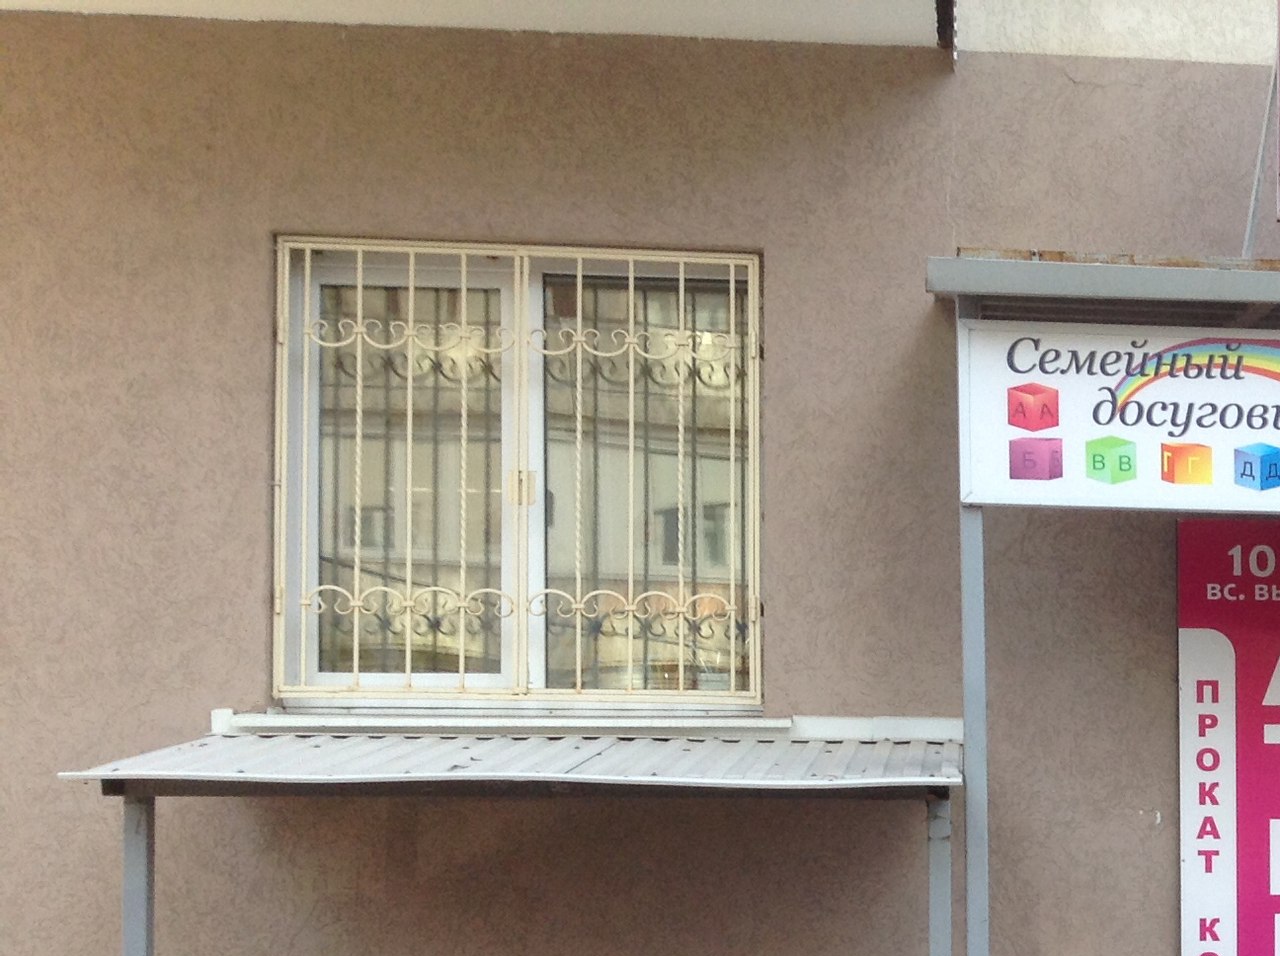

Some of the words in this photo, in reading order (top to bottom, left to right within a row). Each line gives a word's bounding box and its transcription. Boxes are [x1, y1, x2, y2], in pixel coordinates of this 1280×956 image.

[1007, 336, 1245, 381] Семейный
[1228, 545, 1276, 577] 10
[1196, 680, 1221, 873] ПРОКАТ
